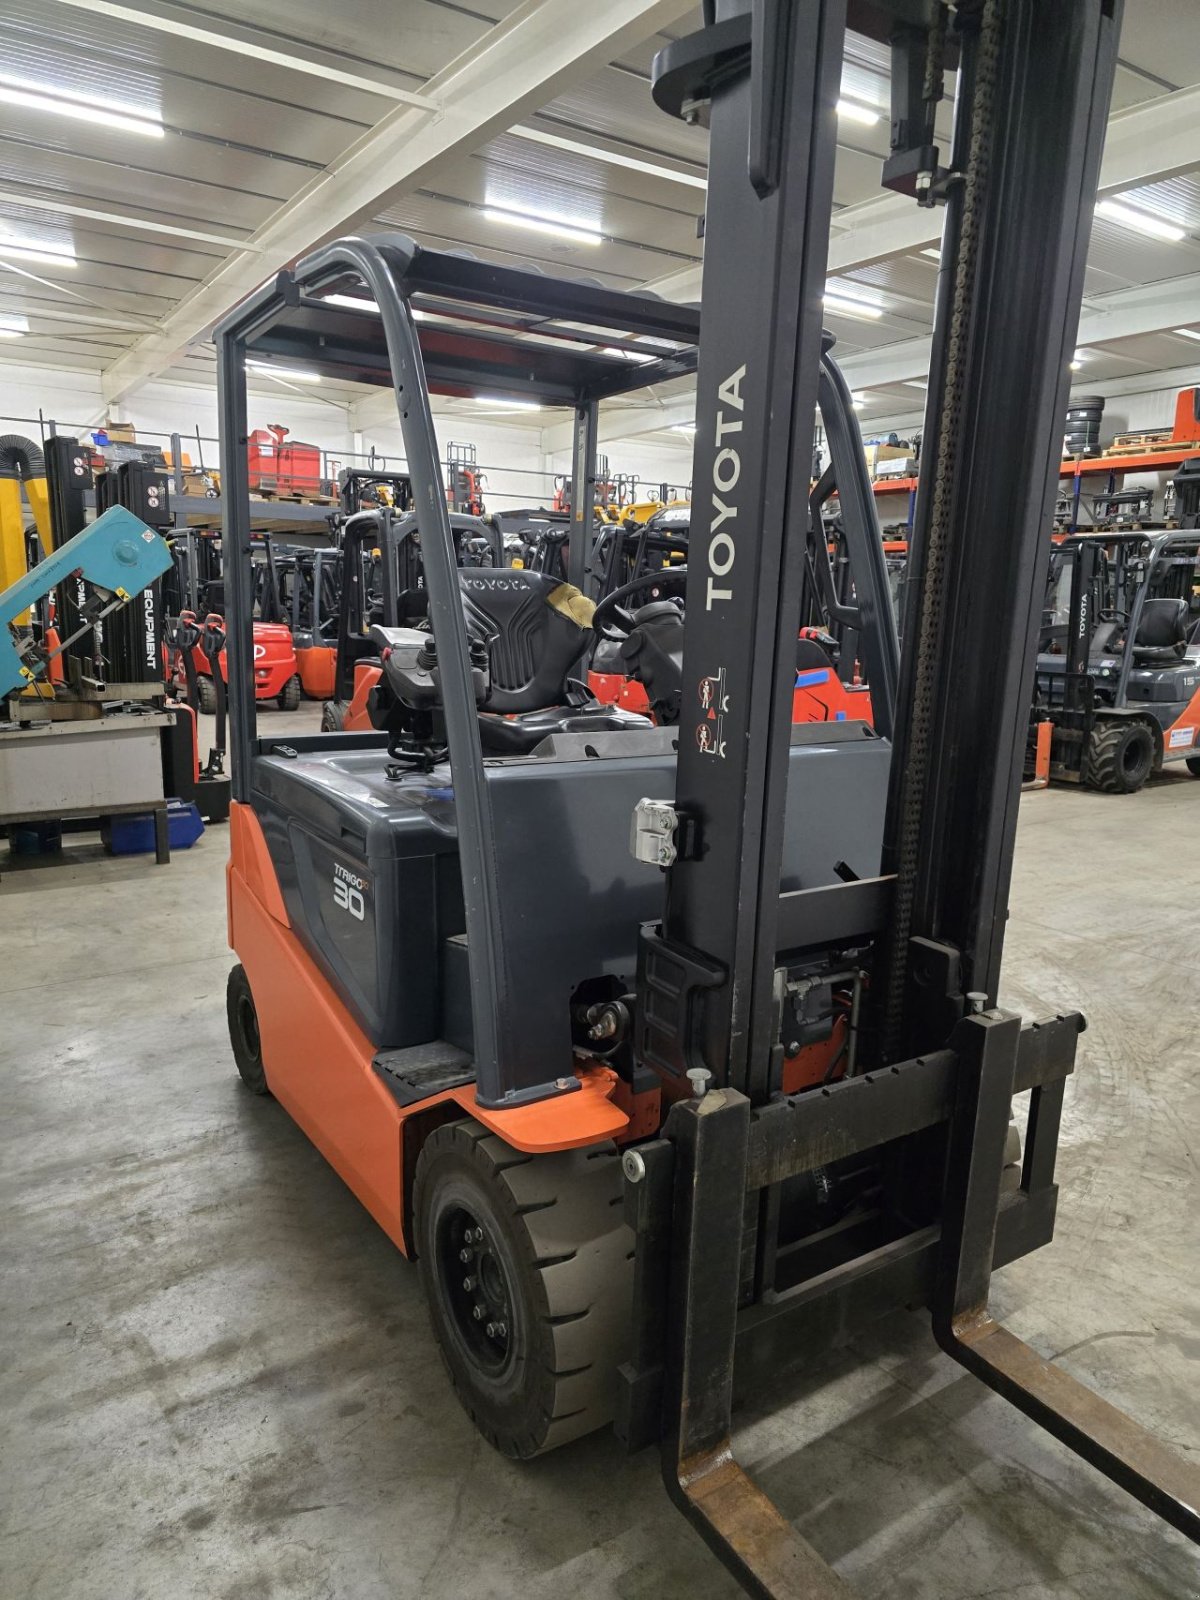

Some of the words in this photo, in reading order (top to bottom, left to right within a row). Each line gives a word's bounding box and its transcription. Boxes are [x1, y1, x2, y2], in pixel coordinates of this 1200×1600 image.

[705, 363, 747, 611] TOYOTA
[461, 577, 531, 591] TOYOTA
[144, 589, 157, 670] EQUIPMENT
[1078, 593, 1088, 639] TOYOTA
[333, 876, 365, 921] 30
